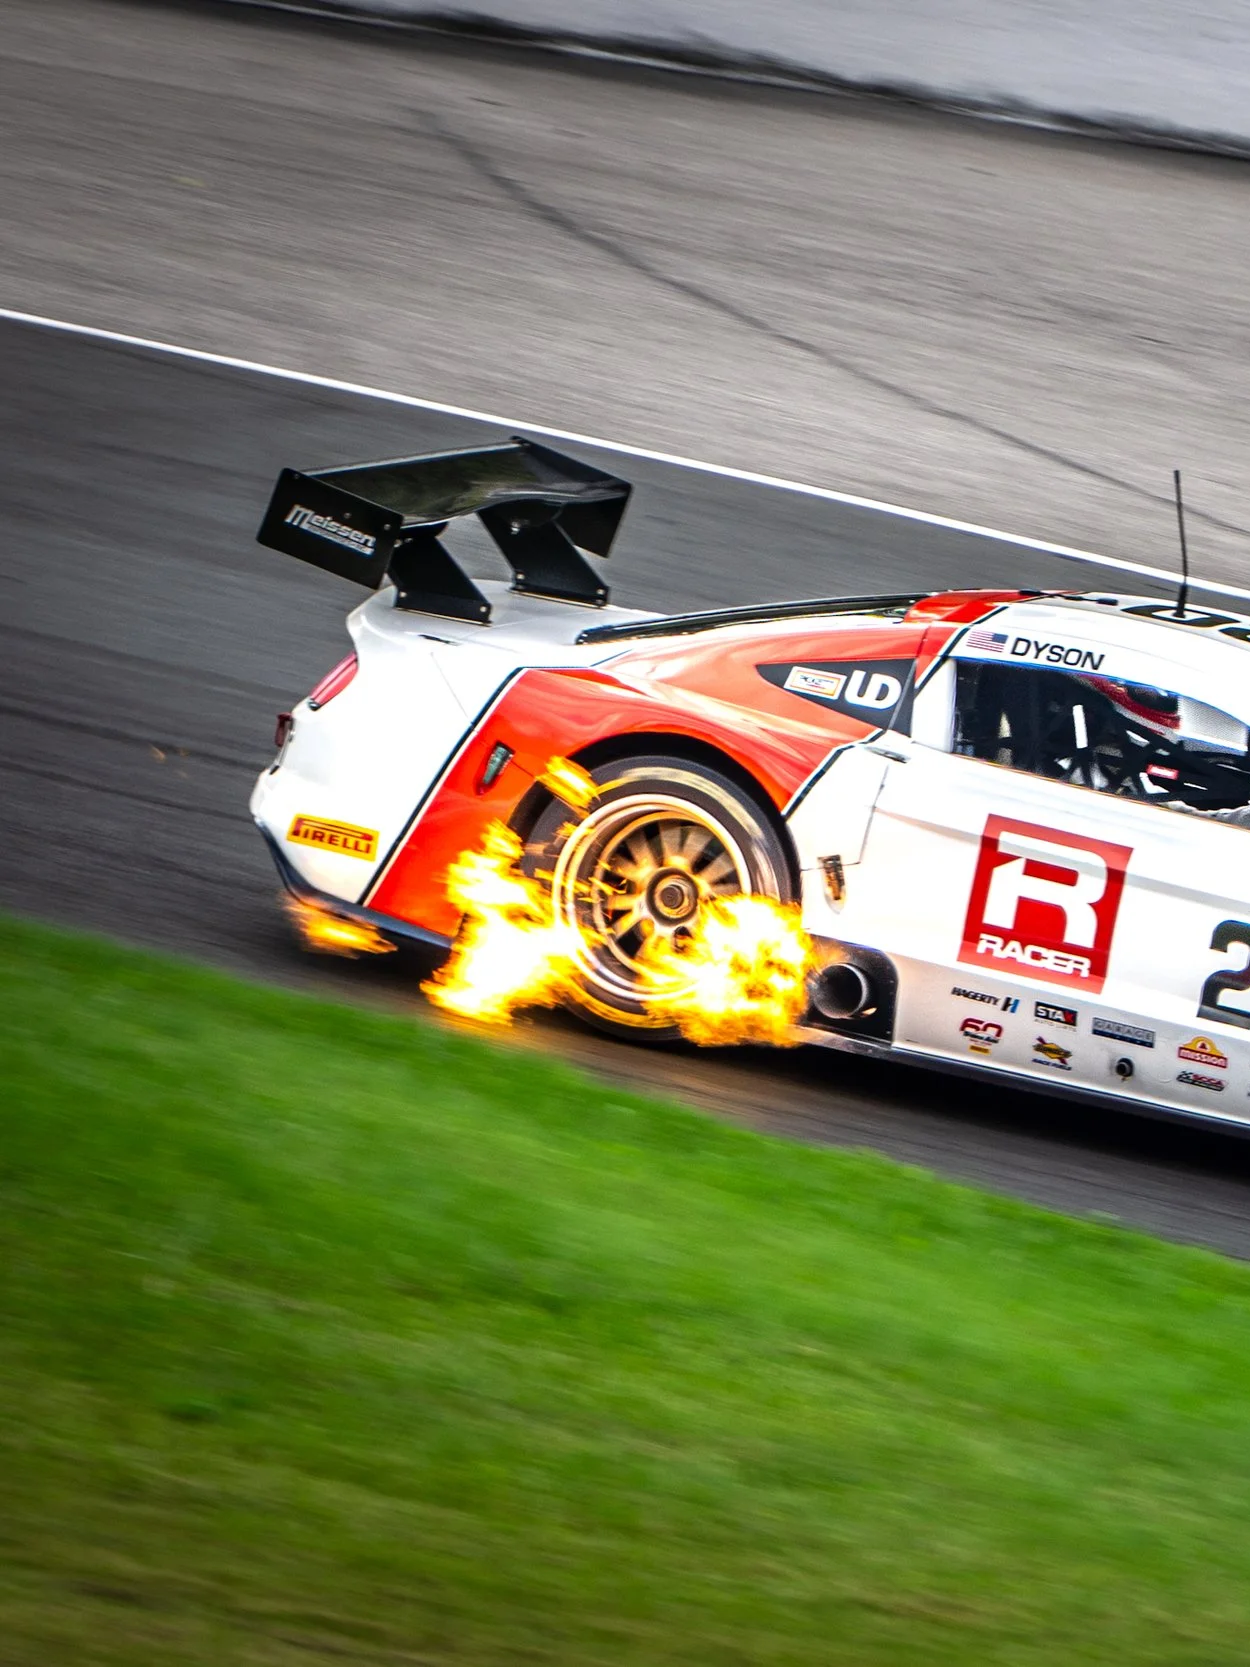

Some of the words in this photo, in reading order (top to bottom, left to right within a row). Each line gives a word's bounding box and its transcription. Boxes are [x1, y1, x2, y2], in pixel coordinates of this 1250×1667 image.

[285, 504, 376, 548] Meissen
[1011, 637, 1105, 671] DYSON
[292, 817, 374, 854] PIRELLI
[976, 932, 1092, 979] RACER
[951, 986, 1001, 1006] HAGERTY
[1095, 1020, 1153, 1040] GARAGE
